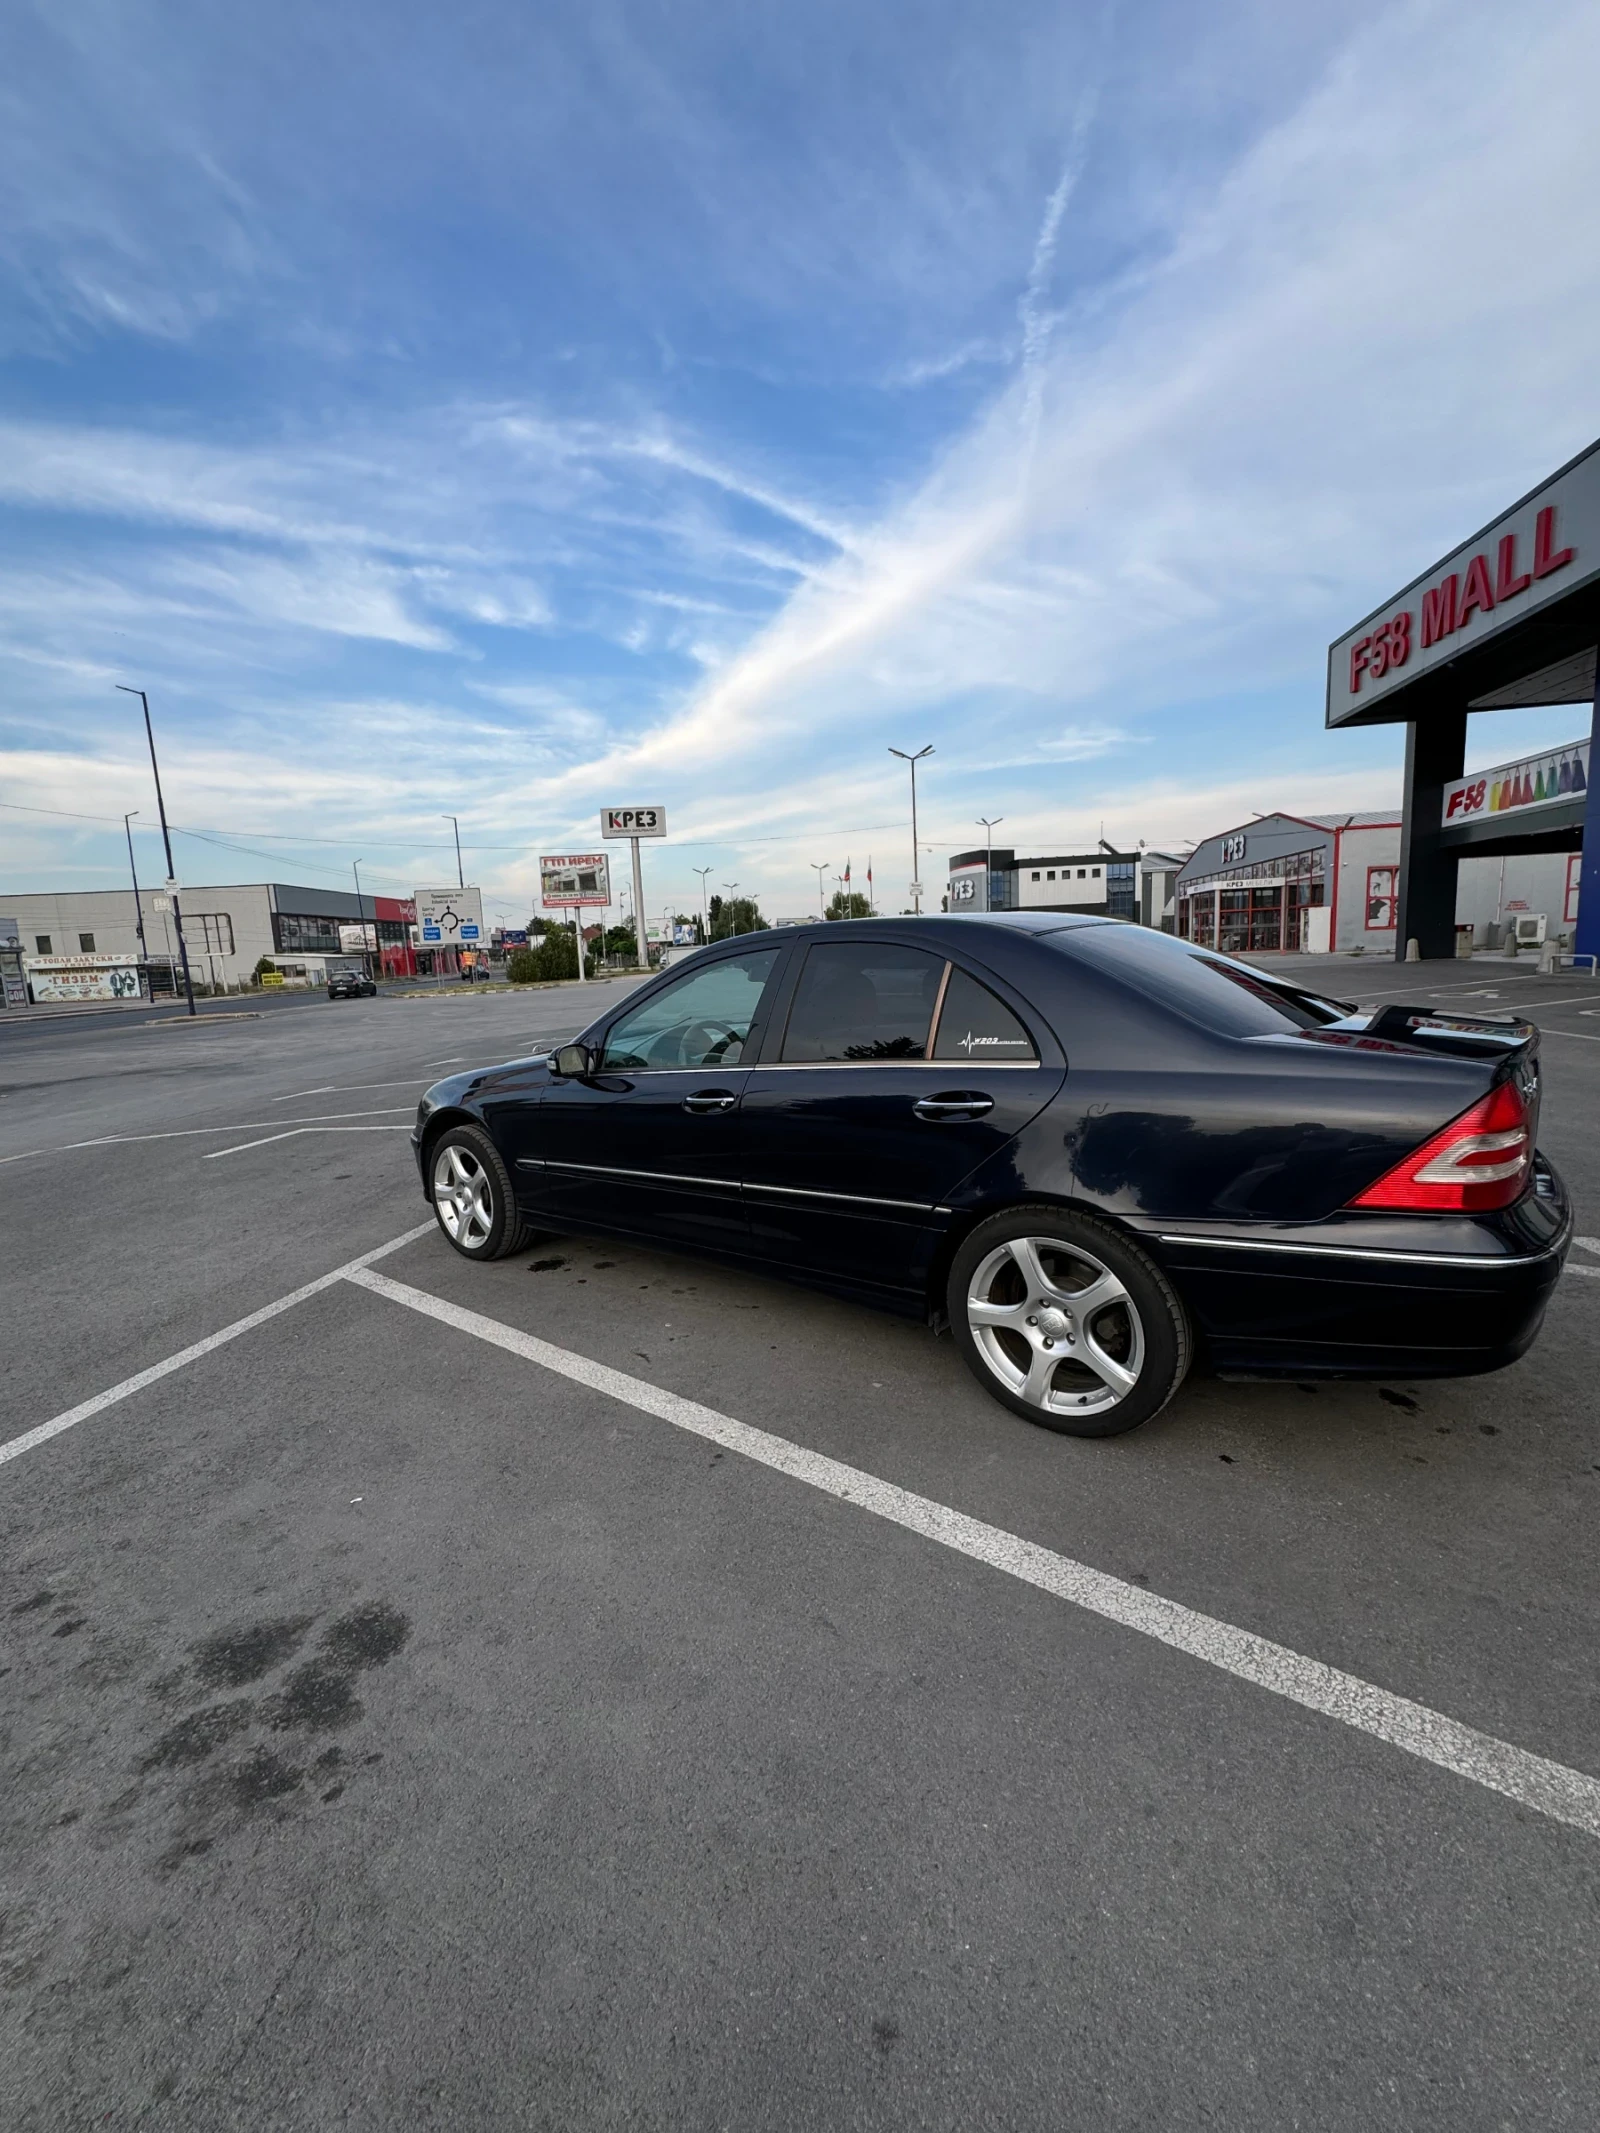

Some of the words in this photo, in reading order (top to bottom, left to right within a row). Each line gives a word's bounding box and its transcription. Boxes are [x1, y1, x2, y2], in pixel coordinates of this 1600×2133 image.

[1350, 611, 1411, 693] F58
[1420, 505, 1573, 649] MALL
[1446, 779, 1487, 819] F58
[608, 811, 657, 829] КРЕЗ
[1221, 834, 1246, 864] КРЕЗ
[543, 858, 566, 867] ГТП
[568, 856, 603, 866] ИРЕМ
[950, 879, 974, 901] КРЕЗ
[73, 955, 113, 963] ЗАКУСКИ
[52, 974, 99, 985] ГИЗЕМ
[974, 1037, 999, 1045] W203
